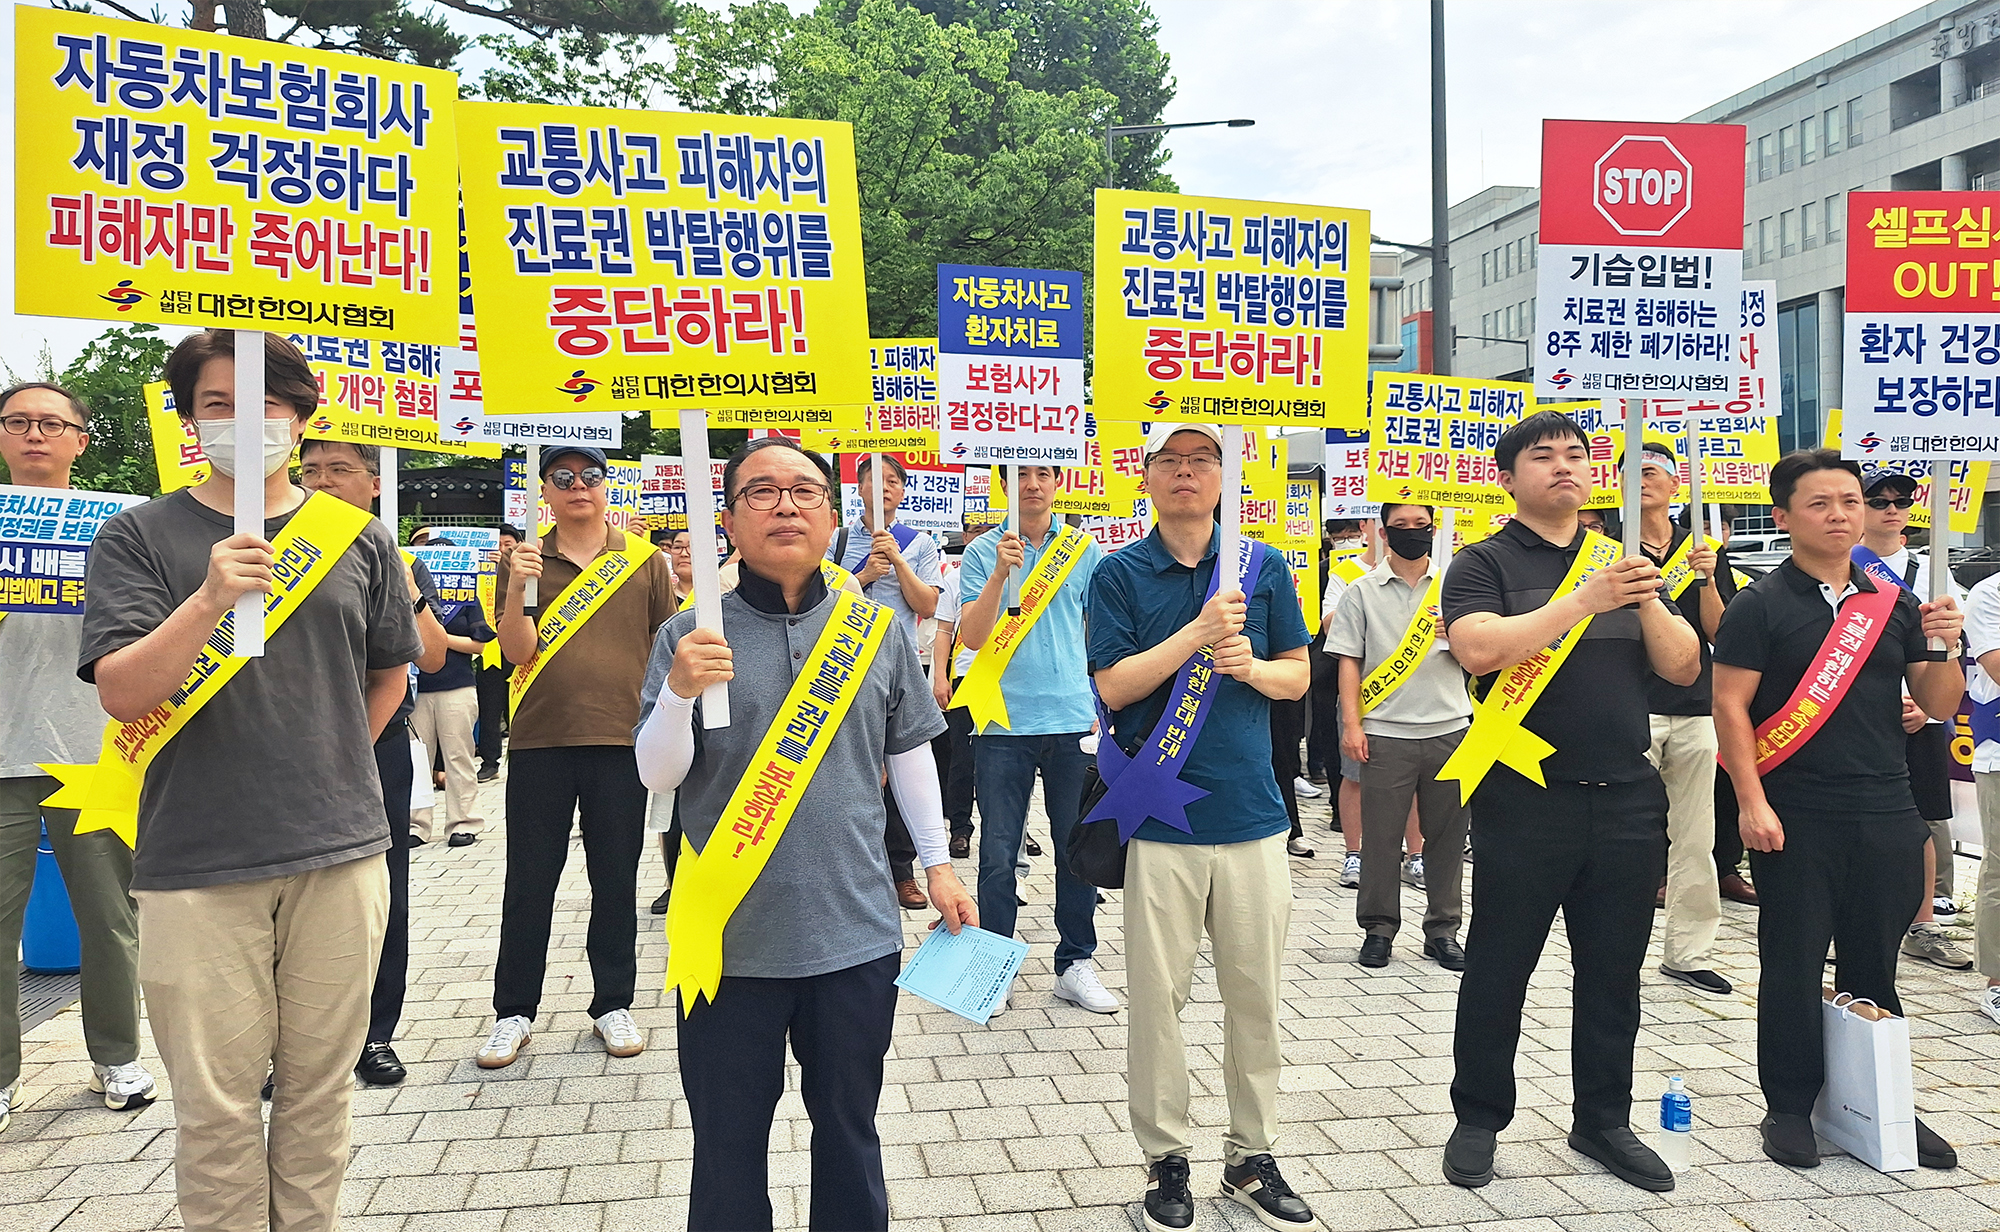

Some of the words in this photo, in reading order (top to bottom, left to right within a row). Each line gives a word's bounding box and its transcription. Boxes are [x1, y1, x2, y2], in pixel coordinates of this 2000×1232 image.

[54, 32, 431, 147] 자동차보험회사
[73, 117, 185, 190] 재정
[209, 132, 414, 217] 걱정하다
[499, 125, 666, 196] 교통사고
[677, 132, 827, 203] 피해자의
[1603, 167, 1683, 206] STOP
[48, 193, 234, 272] 피해자만
[250, 211, 430, 293] 죽어난다!
[508, 205, 632, 274] 진료권
[646, 209, 832, 279] 박탈행위를
[1122, 208, 1233, 261] 교통사고
[1243, 216, 1348, 272] 피해자의
[1569, 254, 1712, 290] 기습입법!
[161, 289, 192, 302] 사단
[161, 301, 192, 315] 법인
[952, 275, 1071, 312] 자동차사고
[1122, 268, 1205, 320] 진료권
[1216, 271, 1347, 330] 박탈행위를
[198, 292, 395, 331] 대한한의사협회
[548, 286, 808, 356] 중단하라!
[1563, 297, 1626, 327] 치료권
[1634, 298, 1718, 329] 침해하는
[964, 313, 1061, 350] 환자치료
[1546, 330, 1582, 359] 8주
[1590, 330, 1632, 361] 제한
[1639, 331, 1730, 362] 폐기하라!
[1858, 321, 1927, 365] 환자
[381, 340, 441, 379] 침해
[884, 345, 936, 372] 피해자
[1143, 327, 1322, 387] 중단하라!
[611, 374, 640, 386] 사단
[644, 372, 817, 399] 대한한의사협회
[872, 375, 937, 402] 침해하는
[965, 361, 1060, 397] 보험사가
[1582, 373, 1602, 381] 사단
[1582, 381, 1602, 390] 법인
[1604, 372, 1729, 393] 대한한의사협회
[337, 374, 385, 414] 개악
[394, 379, 440, 421] 철회
[611, 386, 640, 399] 법인
[1180, 395, 1200, 405] 사단
[1203, 395, 1326, 419] 대한한의사협회
[1385, 381, 1462, 415] 교통사고
[1467, 387, 1524, 420] 피해자
[735, 408, 833, 423] 대한한의사협회
[878, 405, 940, 432] 철회하라!
[945, 400, 1080, 437] 결정한다고?
[1180, 405, 1200, 415] 법인
[341, 421, 358, 429] 사단
[483, 421, 501, 429] 사단
[504, 421, 612, 441] 대한한의사협회
[1385, 415, 1441, 447] 진료권
[858, 436, 927, 448] 대한한의사협회
[990, 445, 1078, 460] 대한한의사협회
[1890, 436, 1910, 444] 사단
[1890, 444, 1910, 452] 법인
[1377, 449, 1410, 479] 자보
[1416, 451, 1450, 482] 개악
[1712, 462, 1771, 487] 신음한다!
[605, 487, 637, 509] 회사
[642, 478, 660, 491] 치료
[923, 475, 960, 493] 건강권
[1286, 483, 1312, 500] 회사
[1331, 475, 1368, 498] 결정
[1430, 489, 1505, 505] 대한한의사협회
[64, 498, 124, 521] 환자의
[640, 495, 685, 514] 보험사
[899, 496, 952, 514] 보장하라!
[668, 512, 689, 530] 입법
[272, 536, 323, 593] 국민의
[434, 550, 451, 560] 아픈
[452, 550, 460, 560] 내
[440, 561, 475, 571] 돈으로?
[594, 552, 630, 586] 국민의
[1039, 548, 1071, 584] 배부르고
[557, 578, 605, 624] 치료받을
[808, 631, 866, 705] 치료받을
[1361, 616, 1433, 706] 대한한의사협회
[1187, 662, 1213, 696] 제한
[1174, 692, 1202, 728] 절대
[776, 699, 830, 766] 권리를
[1156, 723, 1188, 767] 반대!
[731, 760, 796, 860] 보장하라!
